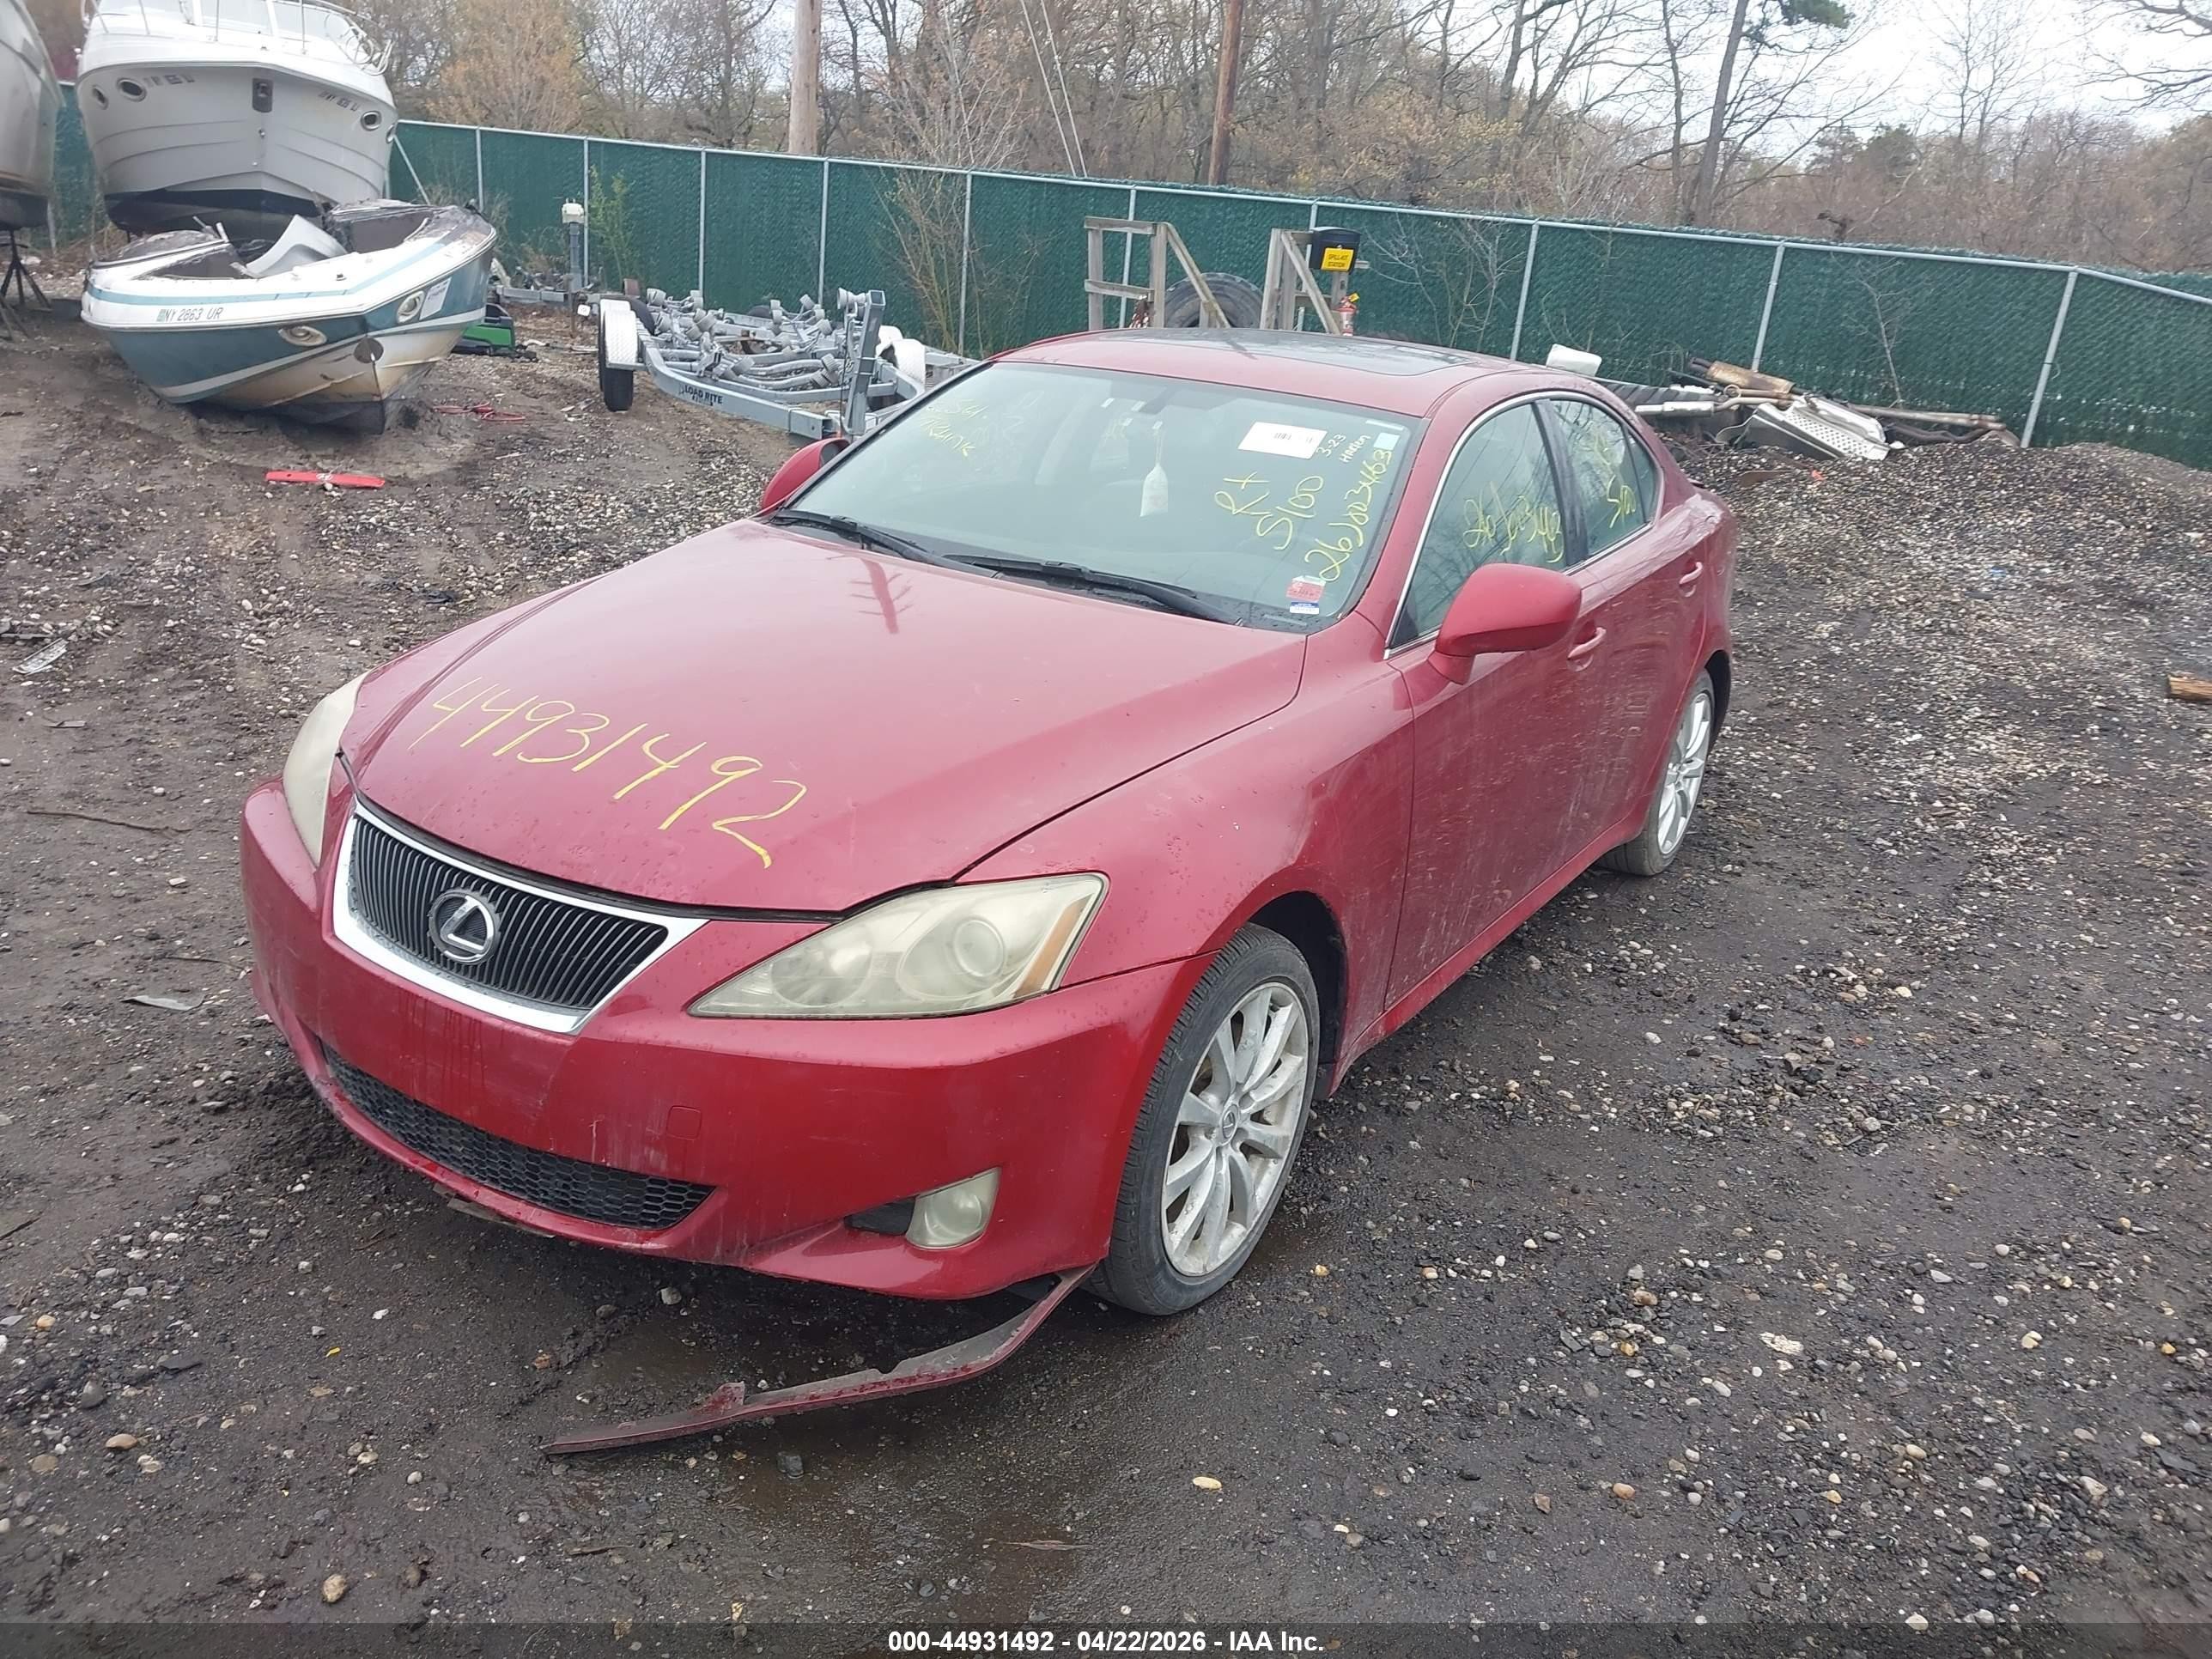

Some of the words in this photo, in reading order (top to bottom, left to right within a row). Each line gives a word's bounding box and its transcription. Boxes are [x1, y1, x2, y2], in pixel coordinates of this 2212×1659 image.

[684, 384, 704, 398] LOAD
[704, 392, 723, 404] RITE
[408, 676, 807, 869] 44931492
